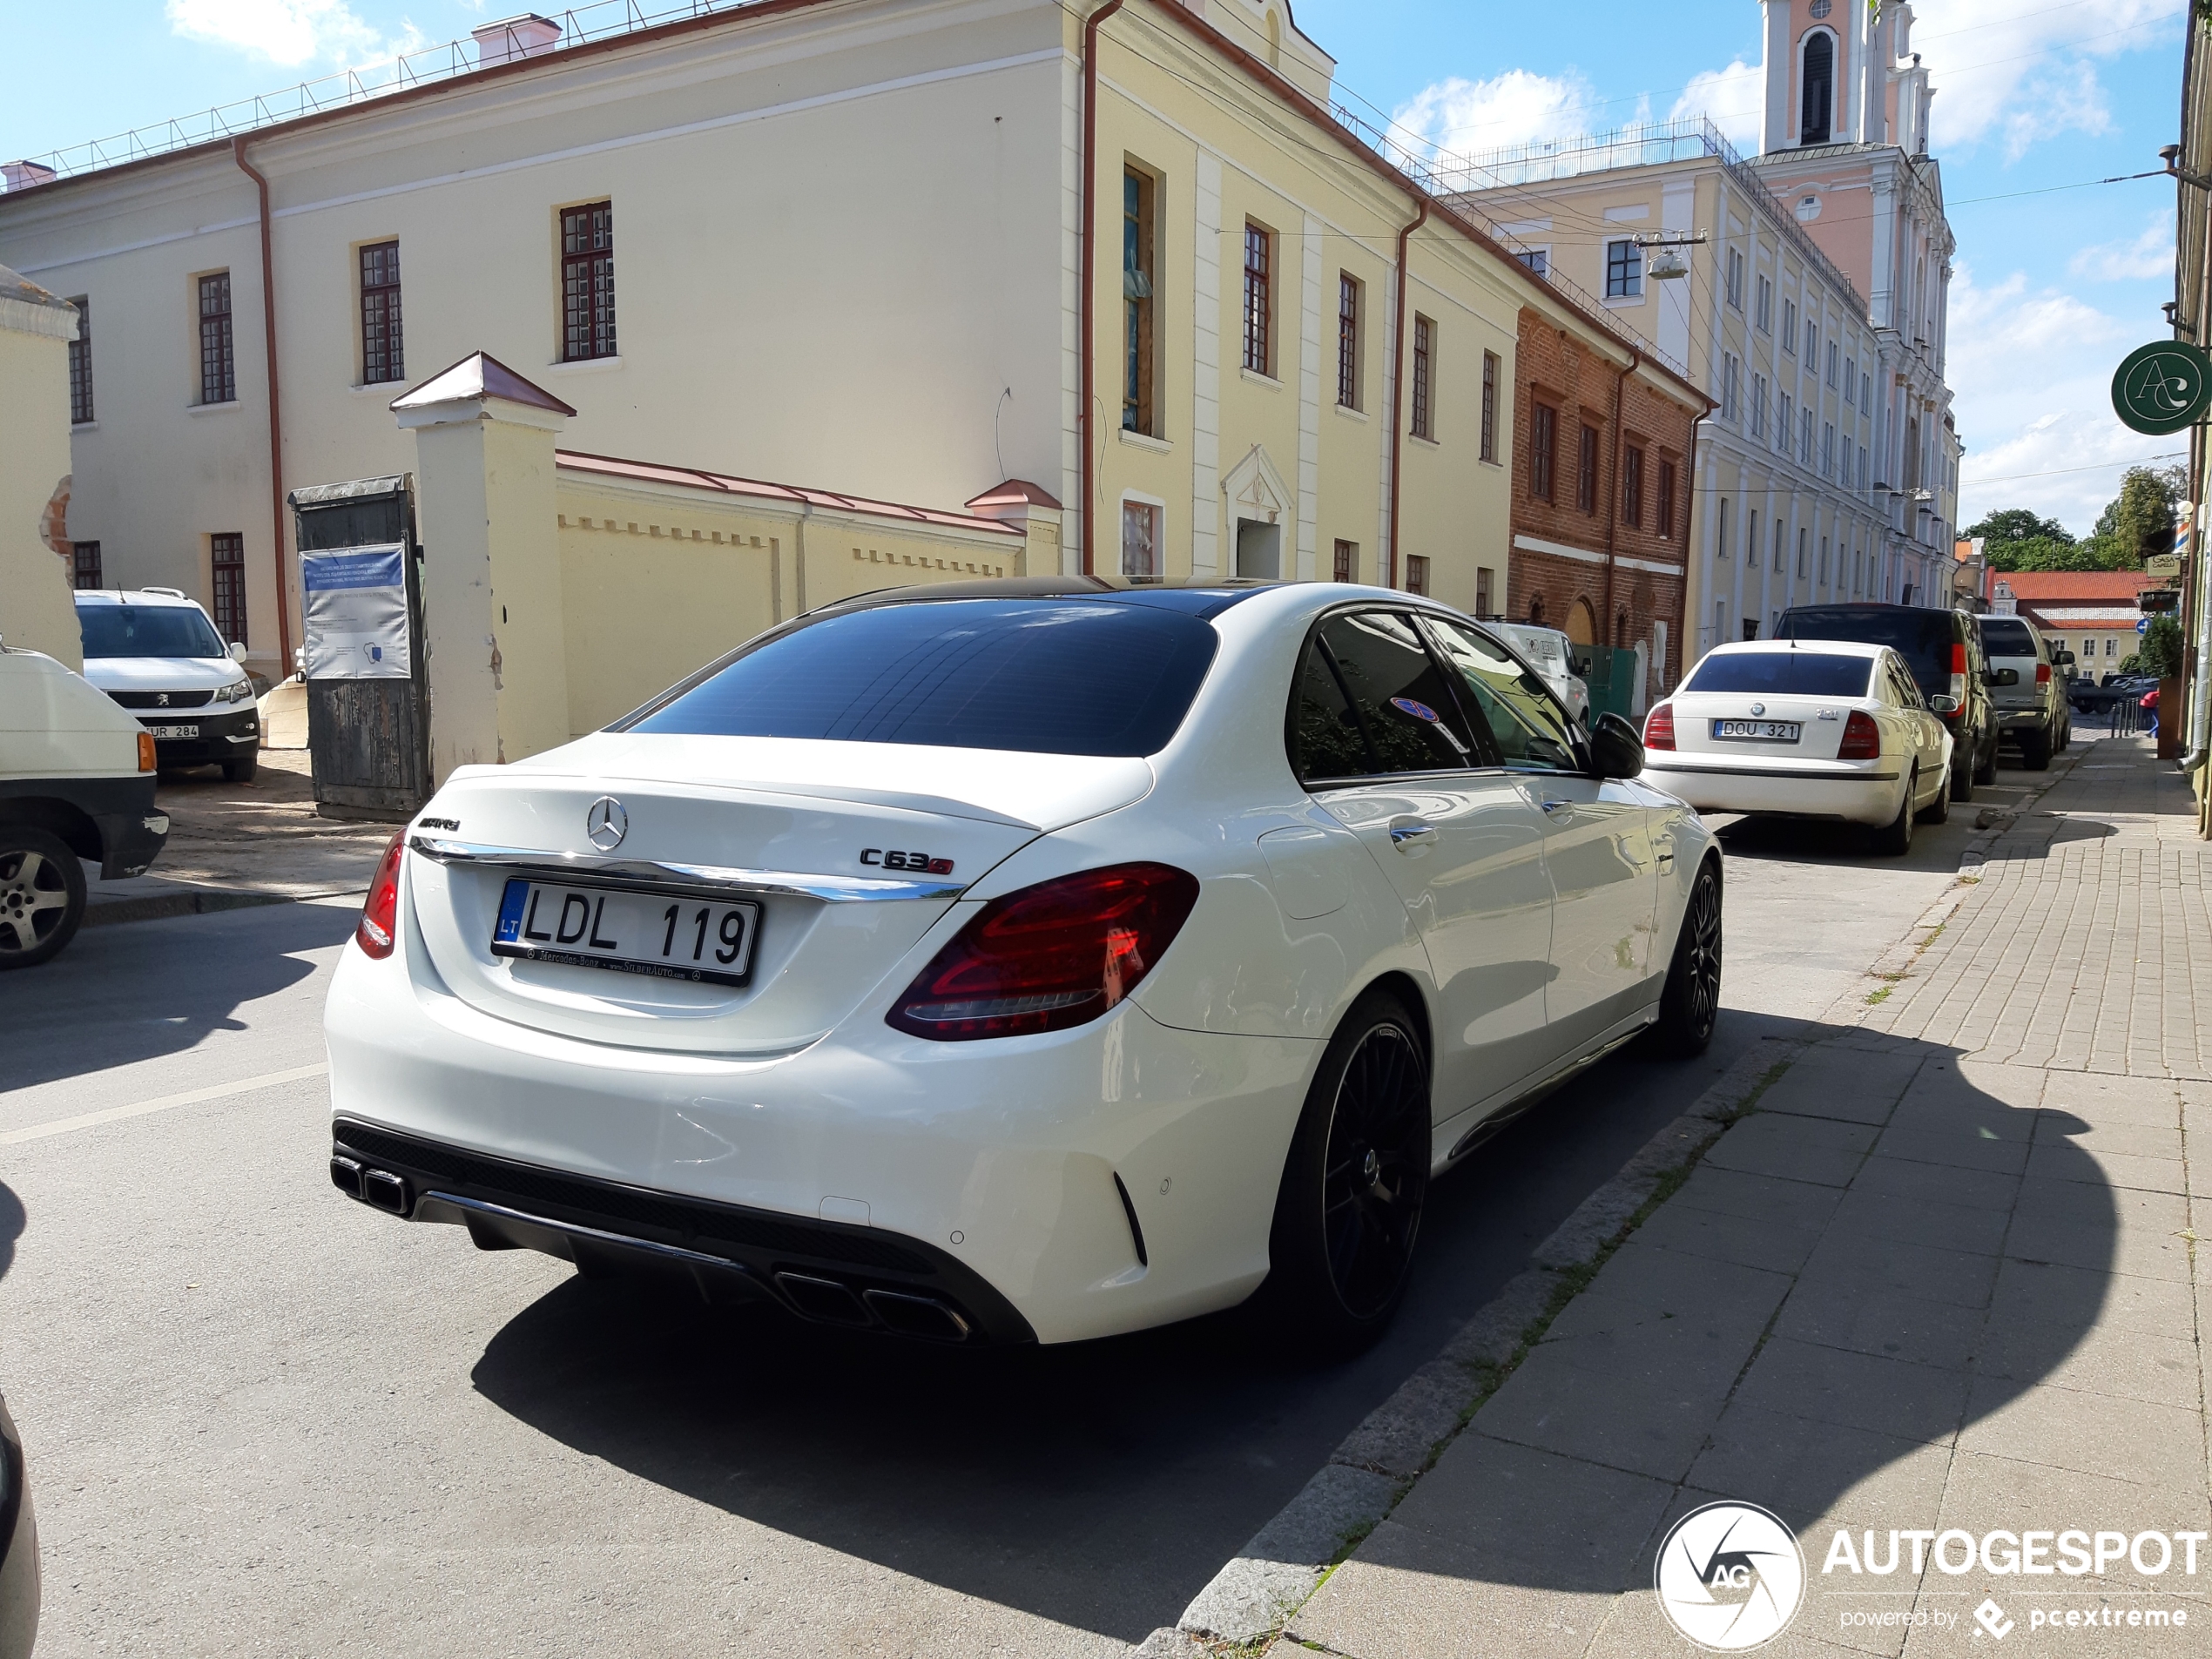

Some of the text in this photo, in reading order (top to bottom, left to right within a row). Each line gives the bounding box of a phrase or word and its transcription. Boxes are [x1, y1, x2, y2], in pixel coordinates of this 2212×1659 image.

[146, 725, 198, 737] UR 284
[1723, 722, 1795, 738] DOU 321
[500, 919, 518, 934] LT
[524, 889, 745, 964] LDL 119
[540, 950, 599, 968] Mercedes-Benz
